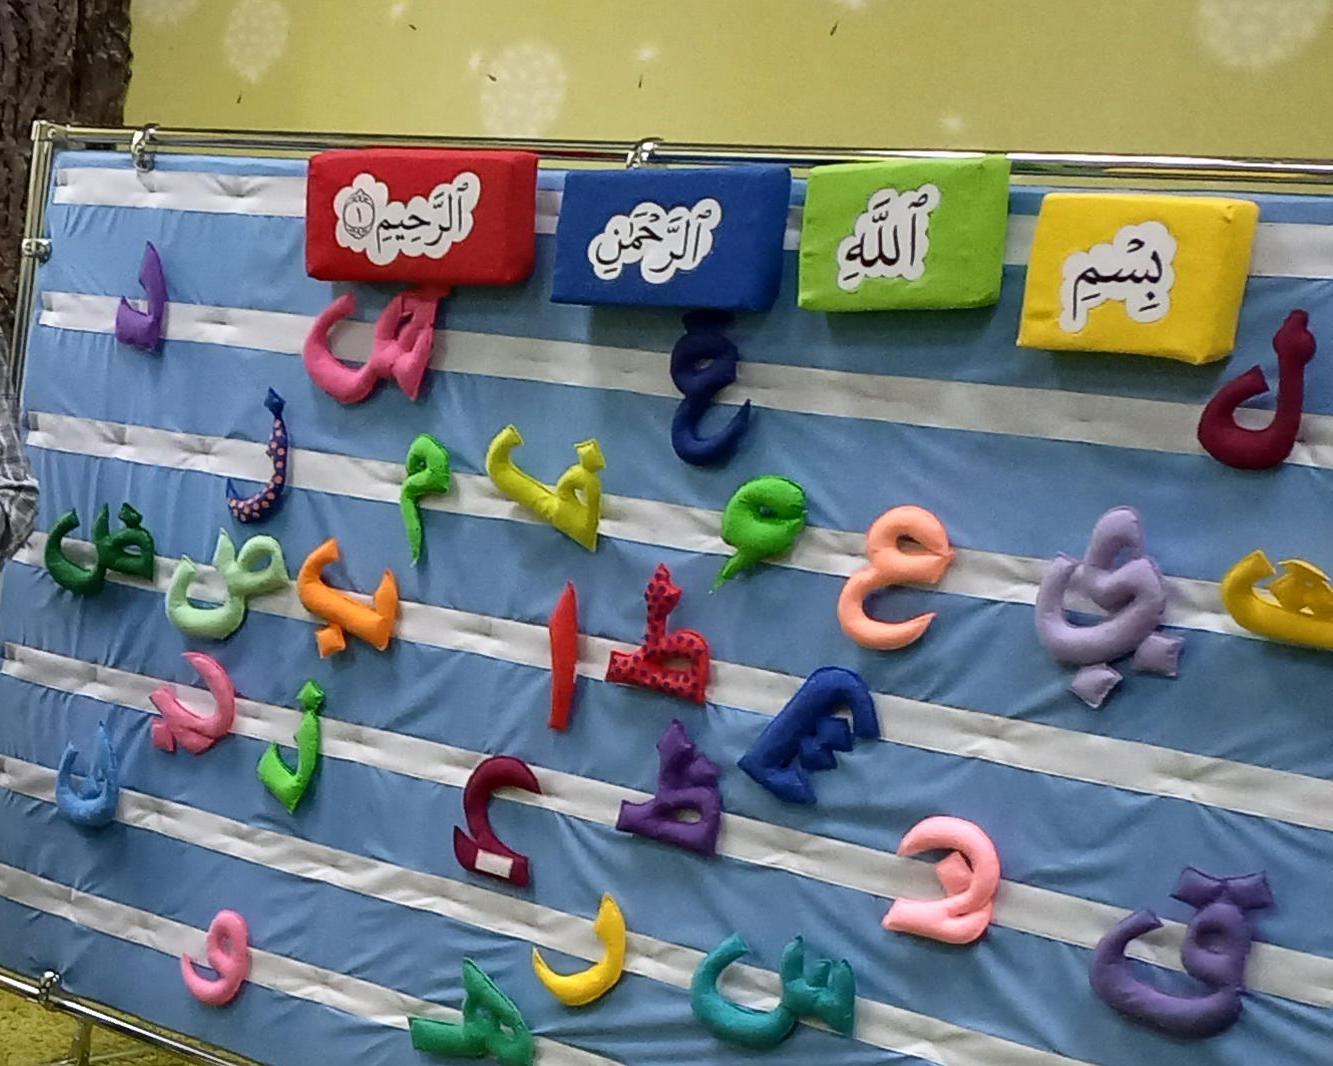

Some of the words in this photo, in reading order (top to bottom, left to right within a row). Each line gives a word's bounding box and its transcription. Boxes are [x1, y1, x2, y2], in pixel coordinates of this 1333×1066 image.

[44, 502, 155, 596] ض
[165, 527, 290, 640] ص
[297, 537, 400, 659] ب
[837, 504, 956, 651] ع
[1035, 505, 1185, 709] ي
[181, 908, 250, 1007] و
[689, 932, 856, 1050] س
[1088, 866, 1274, 1041] ق
